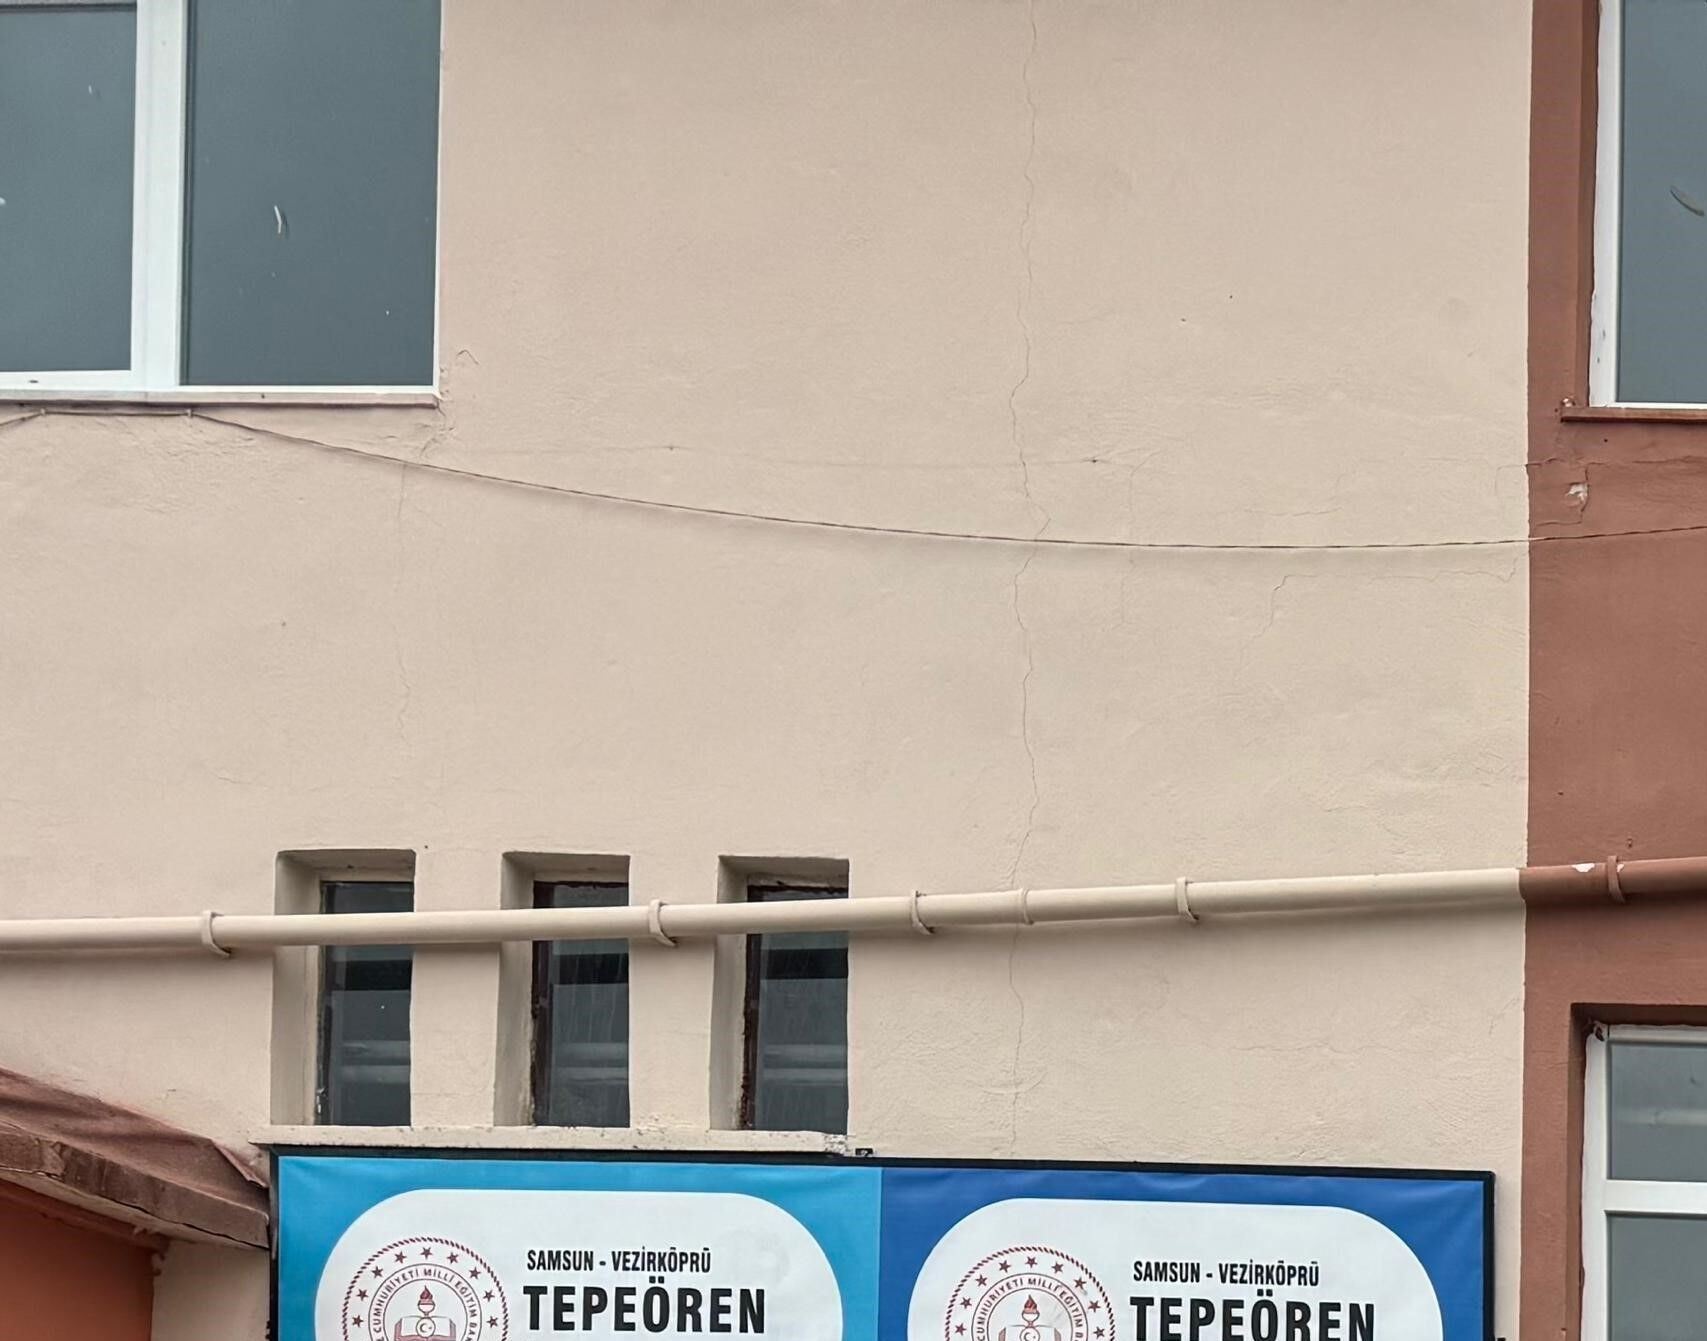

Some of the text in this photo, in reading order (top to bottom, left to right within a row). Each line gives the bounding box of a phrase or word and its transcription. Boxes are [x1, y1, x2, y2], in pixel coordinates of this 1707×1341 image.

[527, 1249, 594, 1272] SAMSUN
[611, 1246, 711, 1273] VEZİRKÖPRÜ
[1133, 1260, 1201, 1283] SAMSUN
[1218, 1259, 1320, 1287] VEZİRKÖPRÜ
[522, 1275, 766, 1335] TEPEÖREN
